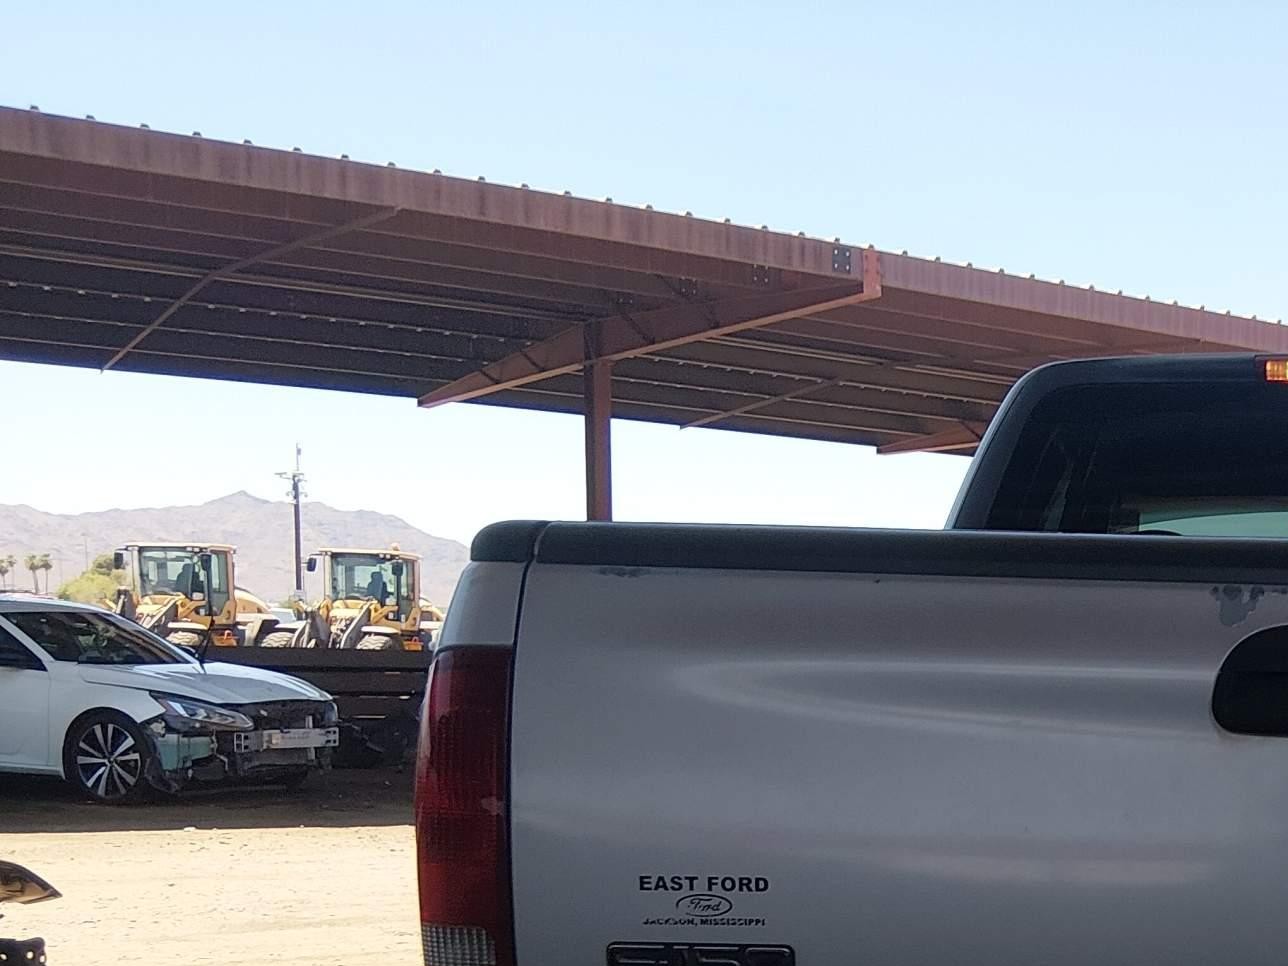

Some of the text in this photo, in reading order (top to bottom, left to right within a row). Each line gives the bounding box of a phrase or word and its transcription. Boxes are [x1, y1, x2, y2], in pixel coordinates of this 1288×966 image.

[638, 875, 769, 892] EAST FORD
[688, 897, 722, 912] Ford
[700, 918, 765, 926] MISSISSIPPI
